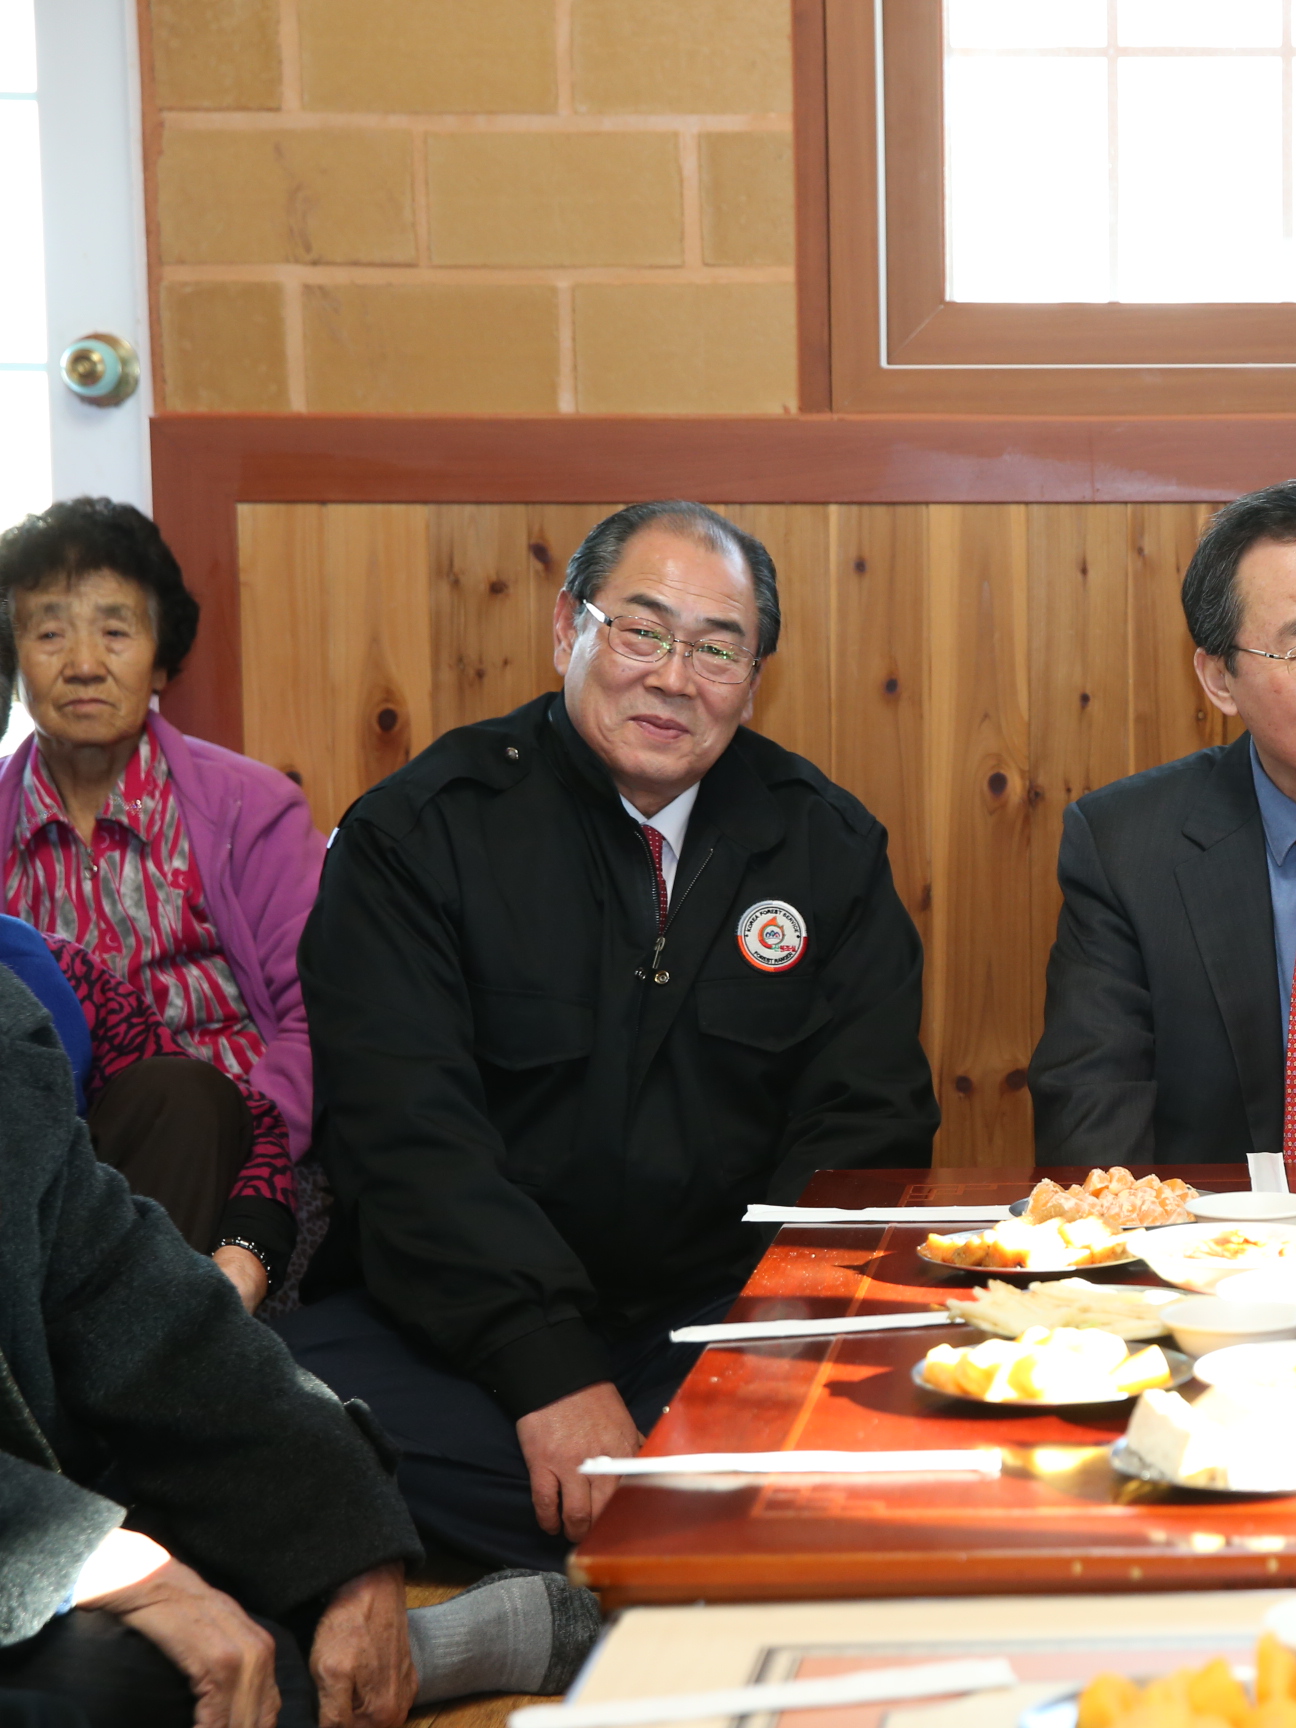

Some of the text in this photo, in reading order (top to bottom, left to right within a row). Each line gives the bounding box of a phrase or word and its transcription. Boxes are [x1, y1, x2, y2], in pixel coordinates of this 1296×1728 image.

[747, 915, 759, 932] KOREA
[783, 913, 799, 932] SERVICE
[754, 951, 793, 964] FOREST RANGER
